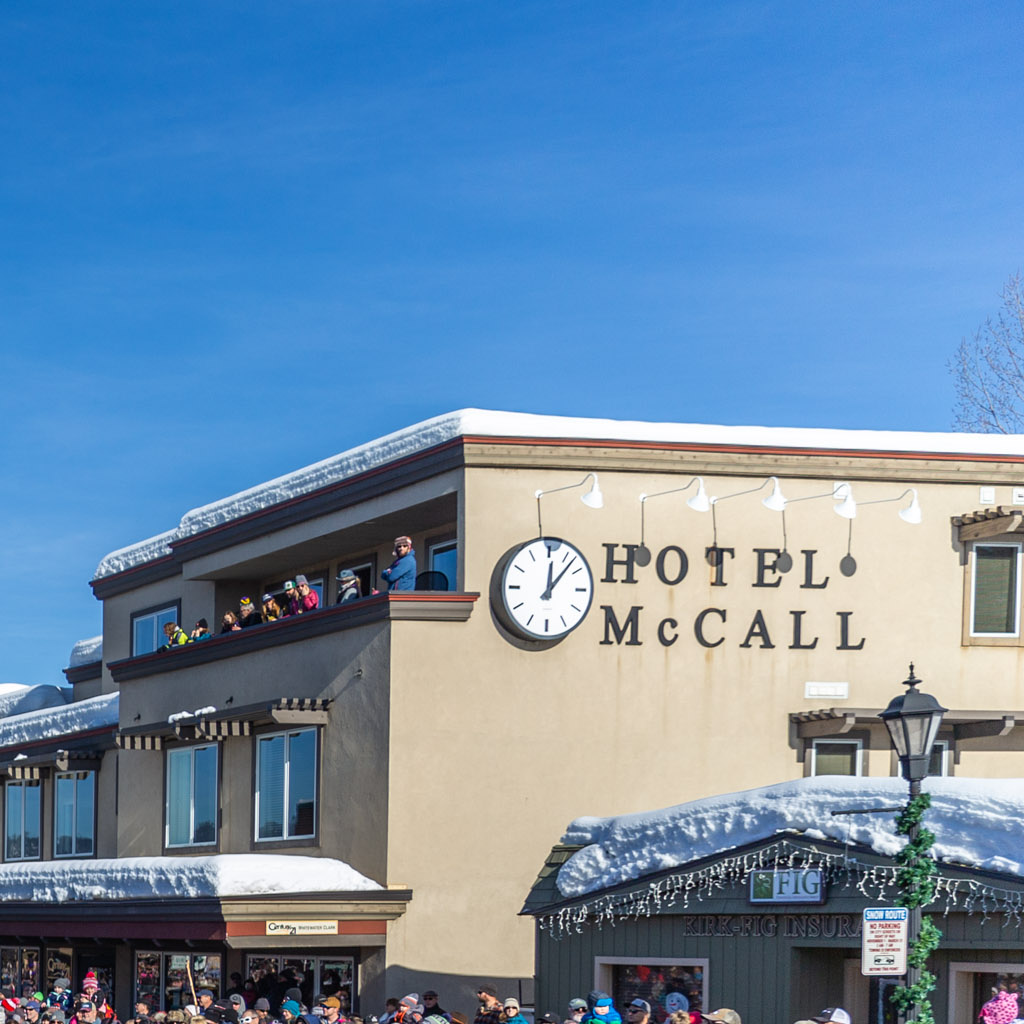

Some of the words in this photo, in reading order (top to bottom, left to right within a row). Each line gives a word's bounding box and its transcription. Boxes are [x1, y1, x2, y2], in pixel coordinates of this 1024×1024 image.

[600, 543, 829, 589] HOTEL
[599, 605, 865, 650] McCALL
[777, 870, 820, 895] FIG
[683, 916, 777, 937] KIRK-FIG
[866, 910, 884, 920] SNOW
[884, 910, 906, 919] ROUTE
